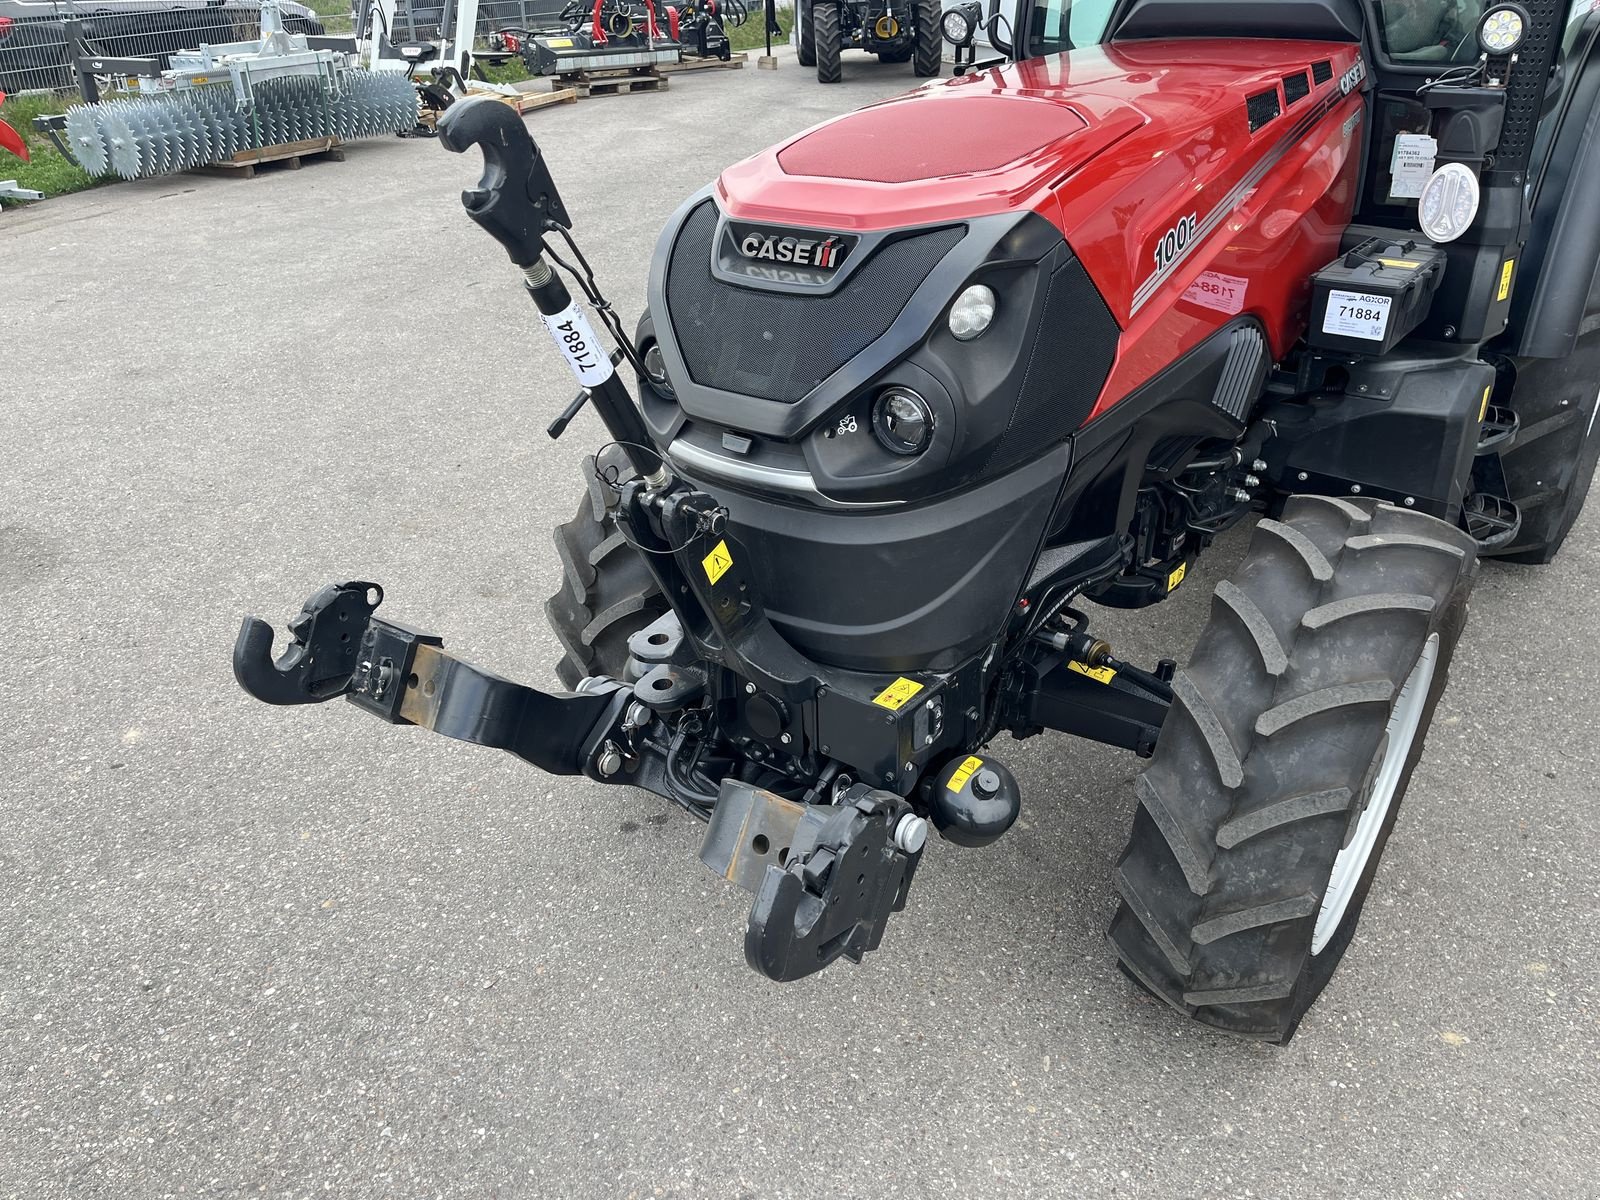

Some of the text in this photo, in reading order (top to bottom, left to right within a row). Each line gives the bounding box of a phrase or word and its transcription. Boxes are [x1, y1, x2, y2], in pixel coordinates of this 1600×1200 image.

[741, 237, 812, 264] CASE
[1154, 211, 1196, 273] 100F
[1339, 305, 1381, 322] 71884
[557, 320, 596, 373] 71884
